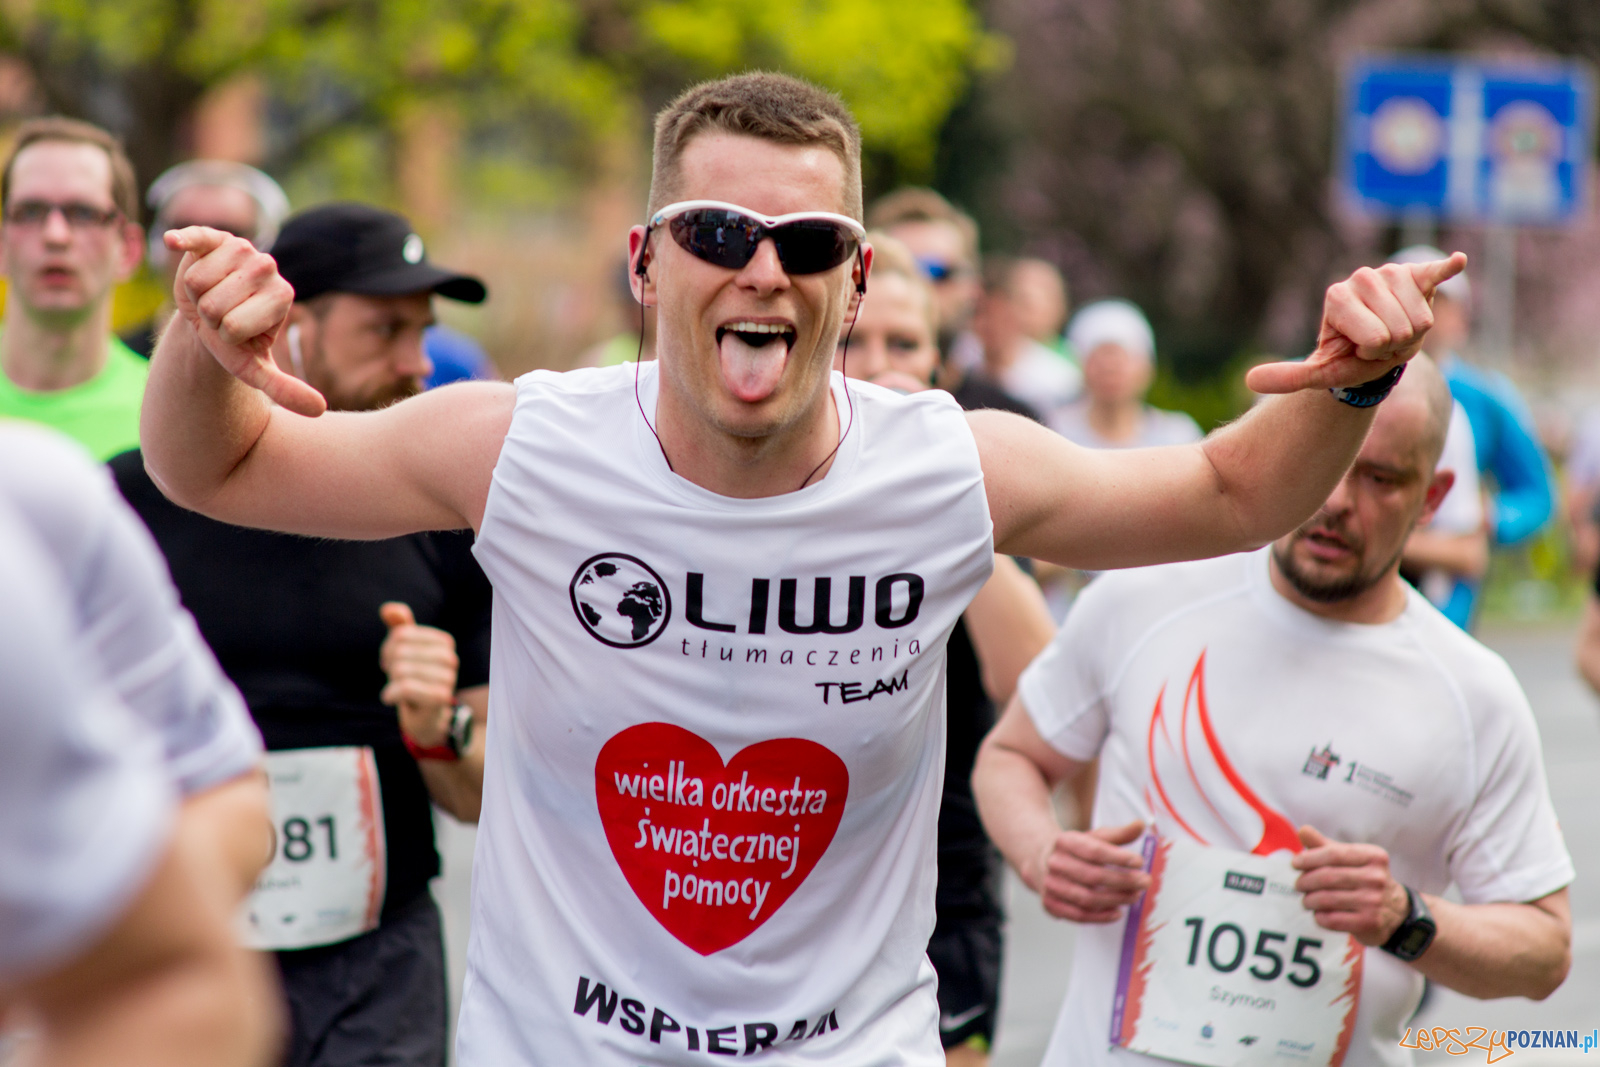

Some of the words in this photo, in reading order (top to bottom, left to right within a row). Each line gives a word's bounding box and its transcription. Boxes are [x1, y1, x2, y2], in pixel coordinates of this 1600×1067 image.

[685, 571, 925, 635] LIWO
[681, 637, 921, 666] tłumaczenia
[814, 669, 909, 705] TEAM
[613, 760, 704, 807] wielka
[711, 770, 828, 817] orkiestra
[269, 813, 339, 863] 81
[634, 806, 801, 880] świątecznej
[662, 869, 771, 921] pomocy
[1184, 915, 1324, 989] 1055
[573, 975, 840, 1057] WSPIERAM
[1209, 984, 1276, 1010] Szymon
